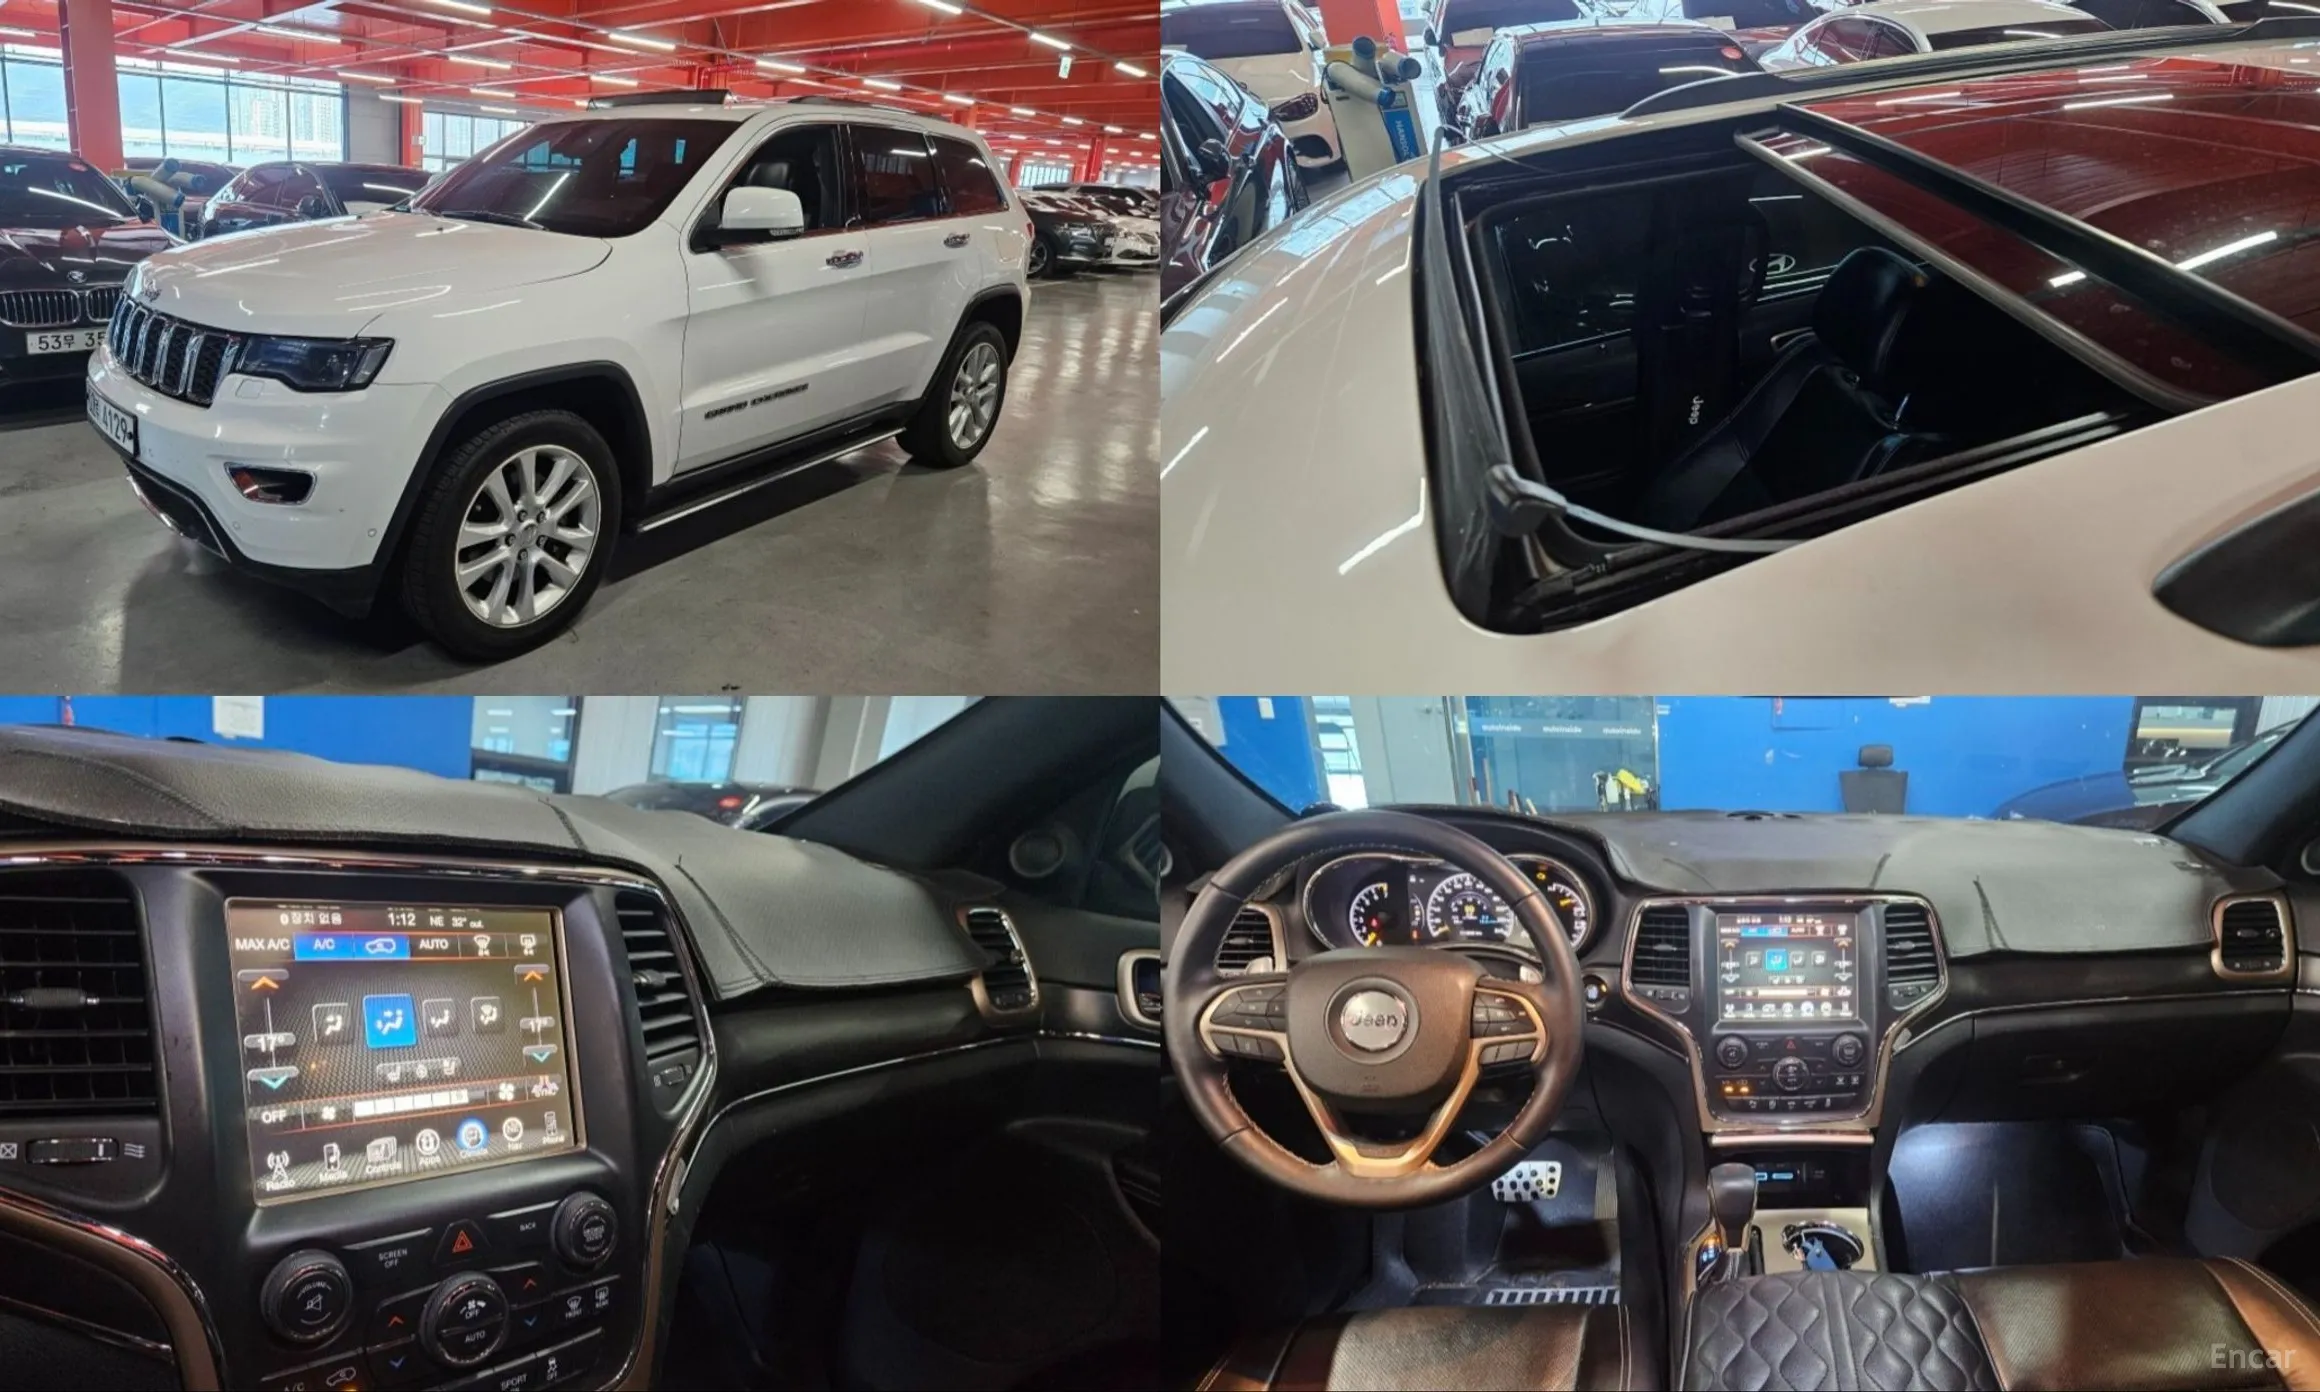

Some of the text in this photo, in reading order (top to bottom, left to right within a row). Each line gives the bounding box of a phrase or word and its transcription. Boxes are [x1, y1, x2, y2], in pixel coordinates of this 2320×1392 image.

[38, 334, 75, 351] 53무
[1690, 395, 1704, 425] Jeep
[102, 404, 128, 444] 4129
[387, 913, 416, 927] 1:12
[430, 915, 444, 927] NE
[235, 938, 290, 951] MAX A/C
[313, 938, 335, 950] A/C
[419, 938, 449, 950] AUTO
[261, 1109, 287, 1124] OFF
[265, 1179, 296, 1192] Radio
[378, 1247, 408, 1261] SCREEN
[464, 1329, 486, 1344] AUTO
